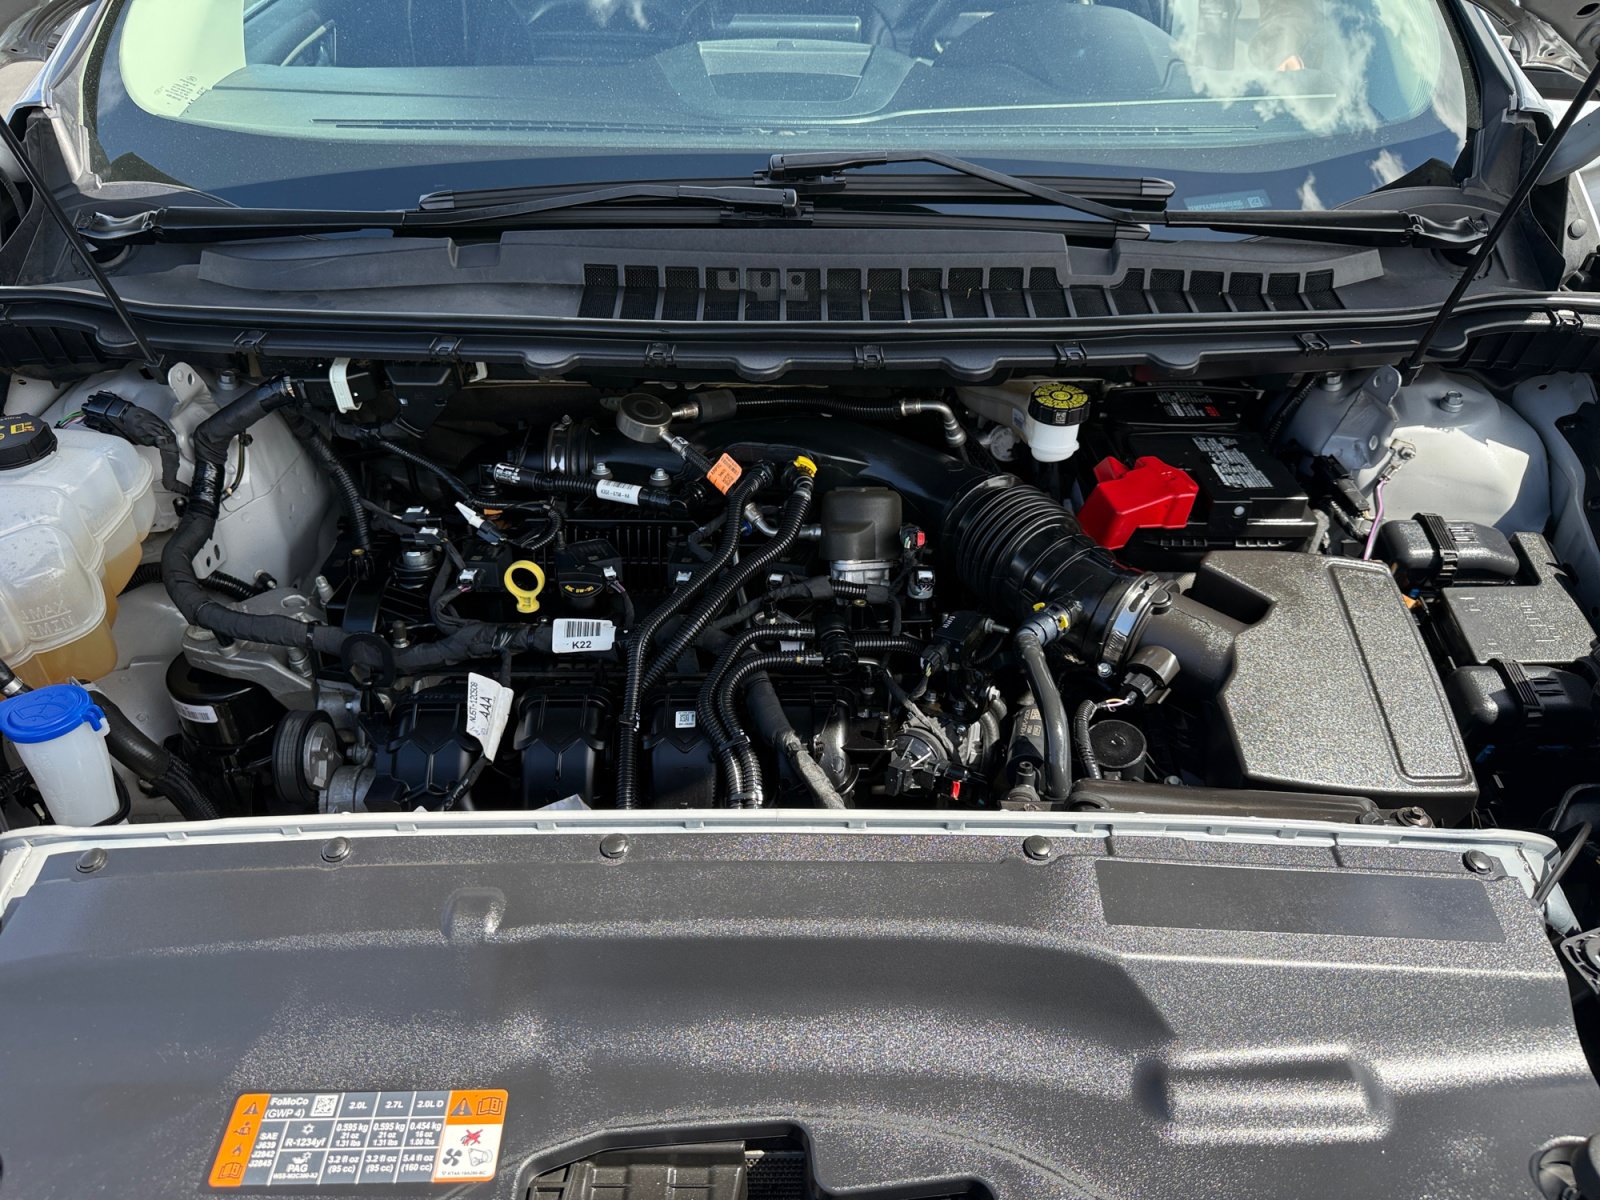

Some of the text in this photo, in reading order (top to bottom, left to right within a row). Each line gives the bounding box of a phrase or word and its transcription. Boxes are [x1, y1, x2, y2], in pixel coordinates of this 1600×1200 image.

[572, 640, 592, 649] K22
[479, 696, 492, 721] AAA
[270, 1097, 309, 1106] FoMoCo
[348, 1101, 367, 1109] 2.0L
[416, 1100, 435, 1108] 2.0L
[264, 1108, 305, 1119] (GWP 4)
[336, 1122, 368, 1133] 0.595 kg
[373, 1122, 406, 1132] 0.595 kg
[410, 1121, 442, 1131] 0.454 kg
[259, 1132, 278, 1140] SAE
[255, 1141, 276, 1149] J639
[284, 1137, 327, 1148] R-1234yf
[328, 1155, 341, 1163] 3.2
[341, 1155, 349, 1163] fl
[365, 1154, 378, 1162] 3.2
[379, 1154, 386, 1162] fl
[286, 1163, 308, 1172] PAG
[327, 1165, 356, 1174] (95 cc)
[365, 1164, 394, 1173] (95 cc)
[419, 1163, 433, 1172] cc)
